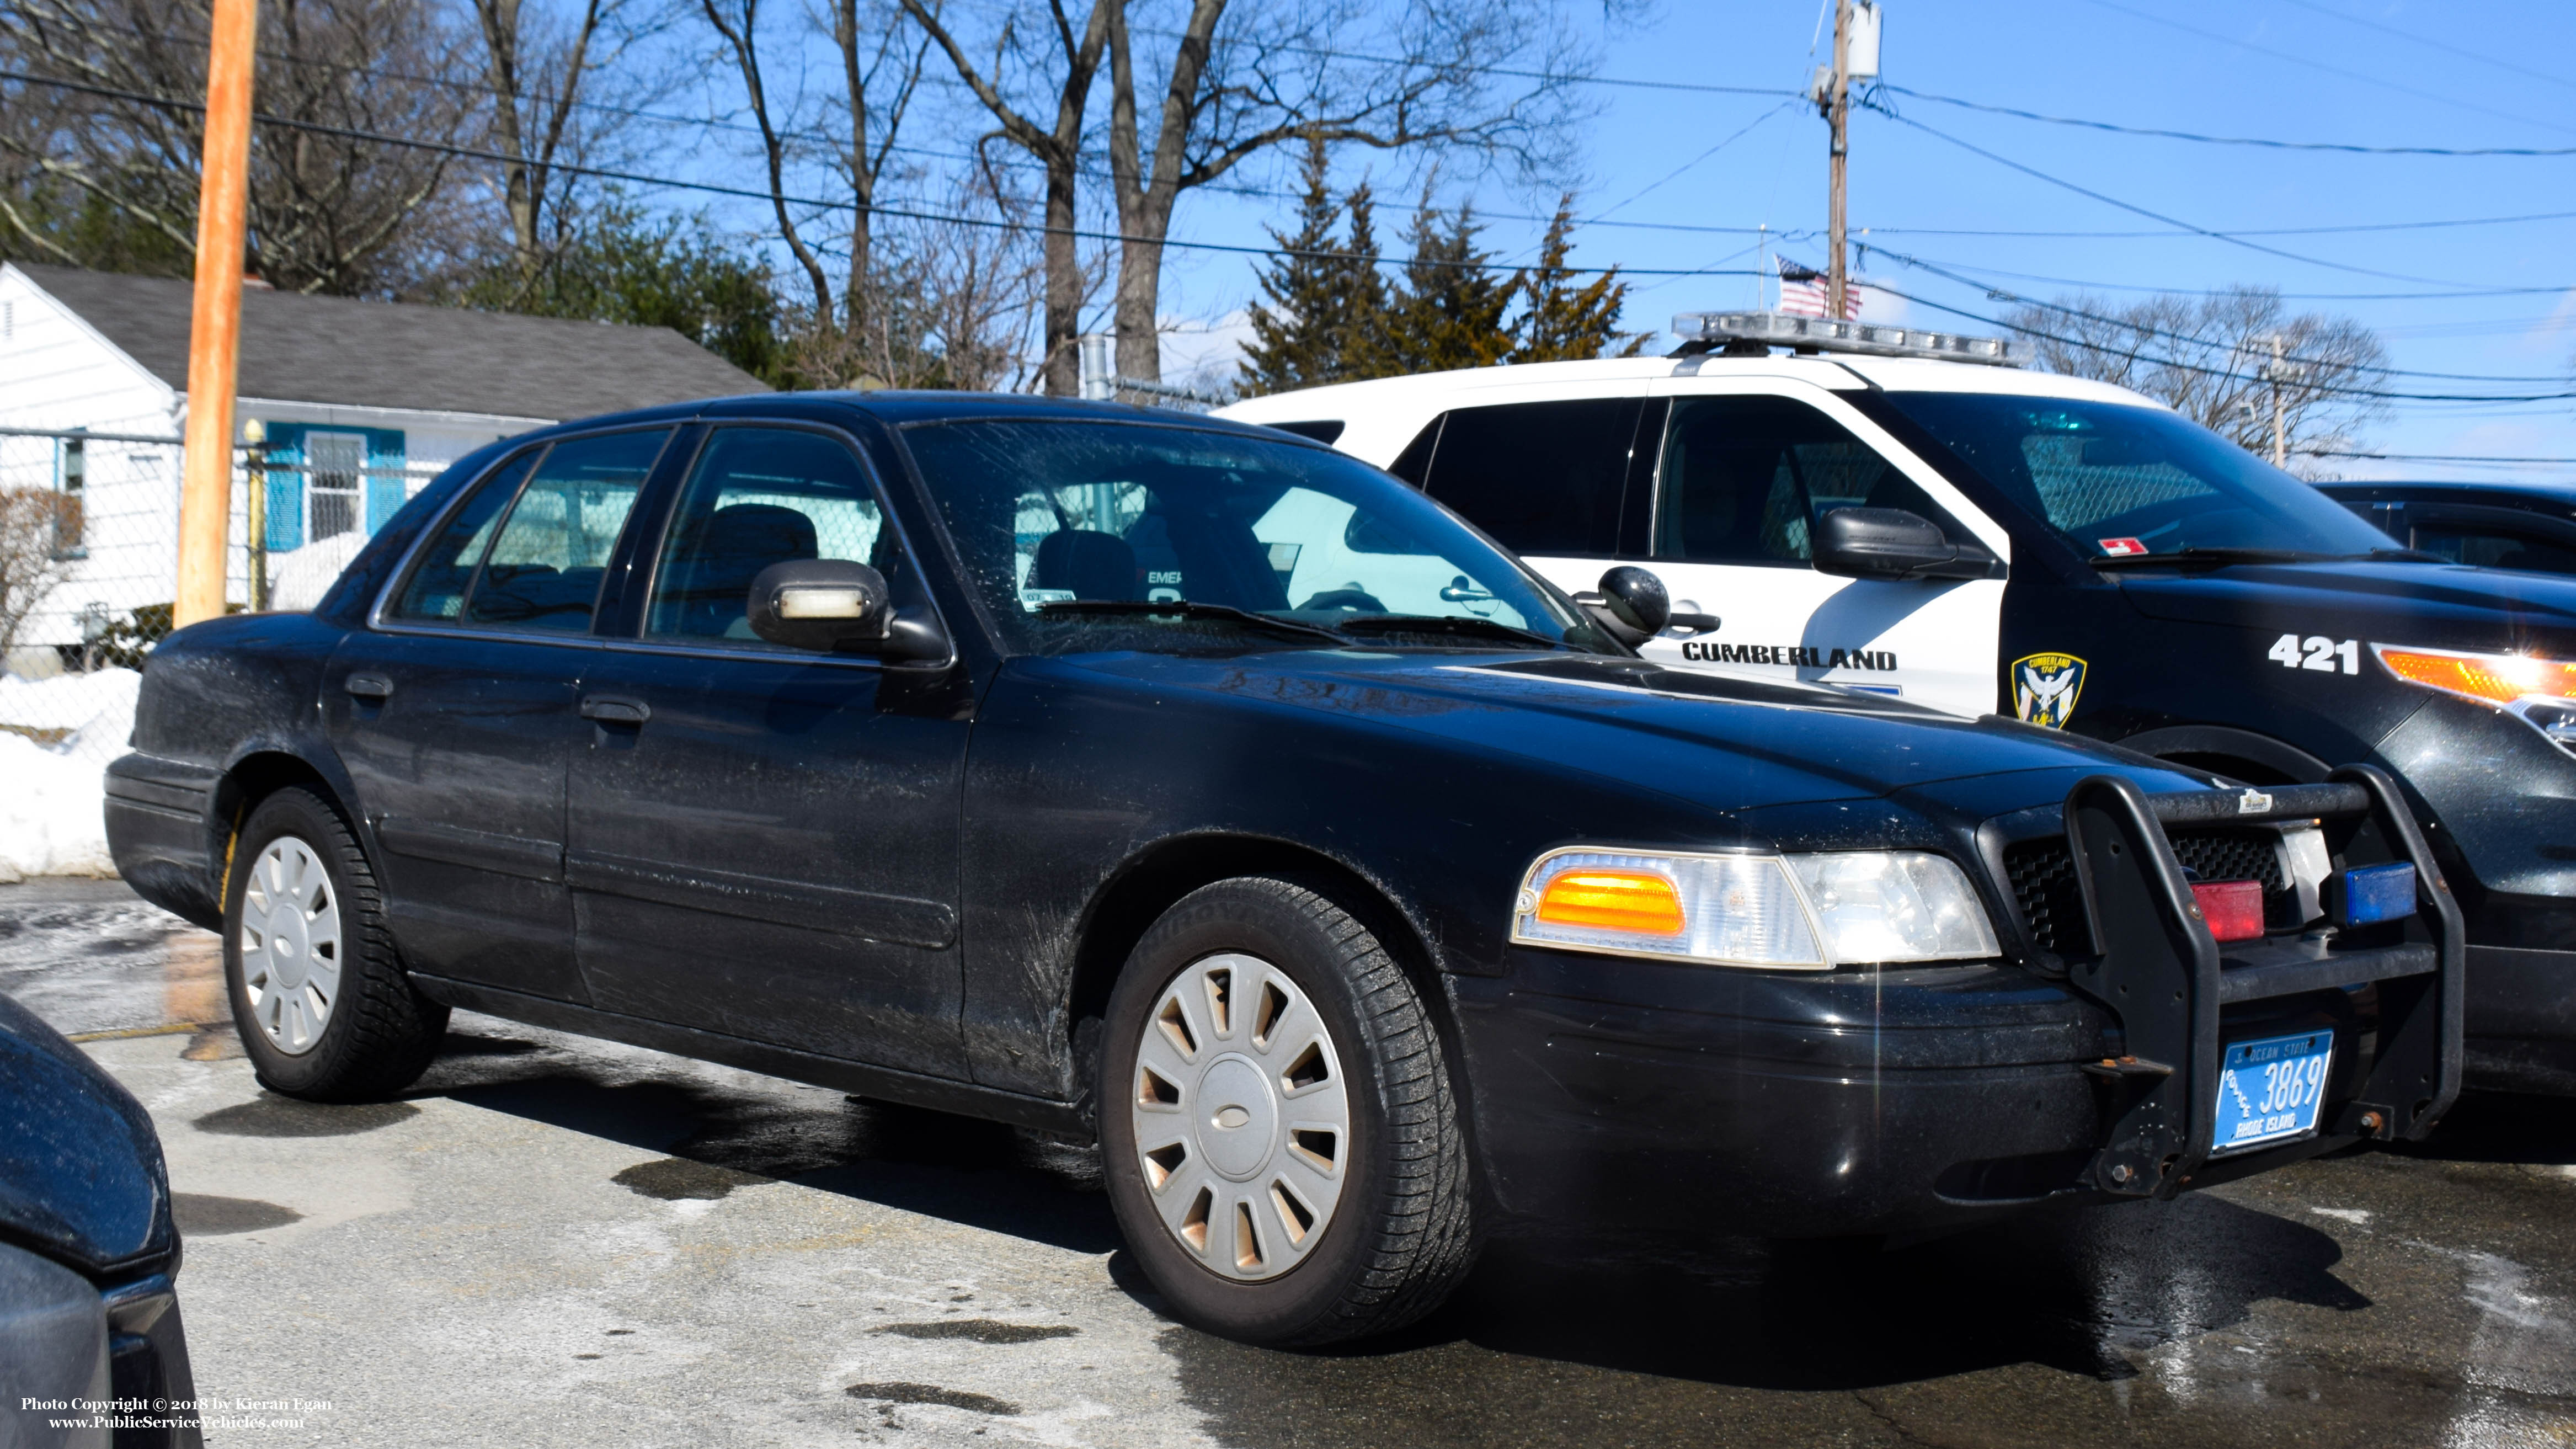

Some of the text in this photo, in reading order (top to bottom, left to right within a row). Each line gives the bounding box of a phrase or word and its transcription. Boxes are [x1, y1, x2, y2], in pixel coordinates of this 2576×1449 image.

[1682, 642, 1897, 671] CUMBERLAND
[2029, 657, 2071, 668] CUMBERLAND
[2268, 634, 2359, 675] 421
[2041, 665, 2058, 674] 1747
[2249, 1041, 2310, 1062] OCEAN STATE
[2226, 1069, 2251, 1118] POLICE
[2259, 1056, 2322, 1114] 3869
[2236, 1113, 2296, 1139] RHODE ISLAND
